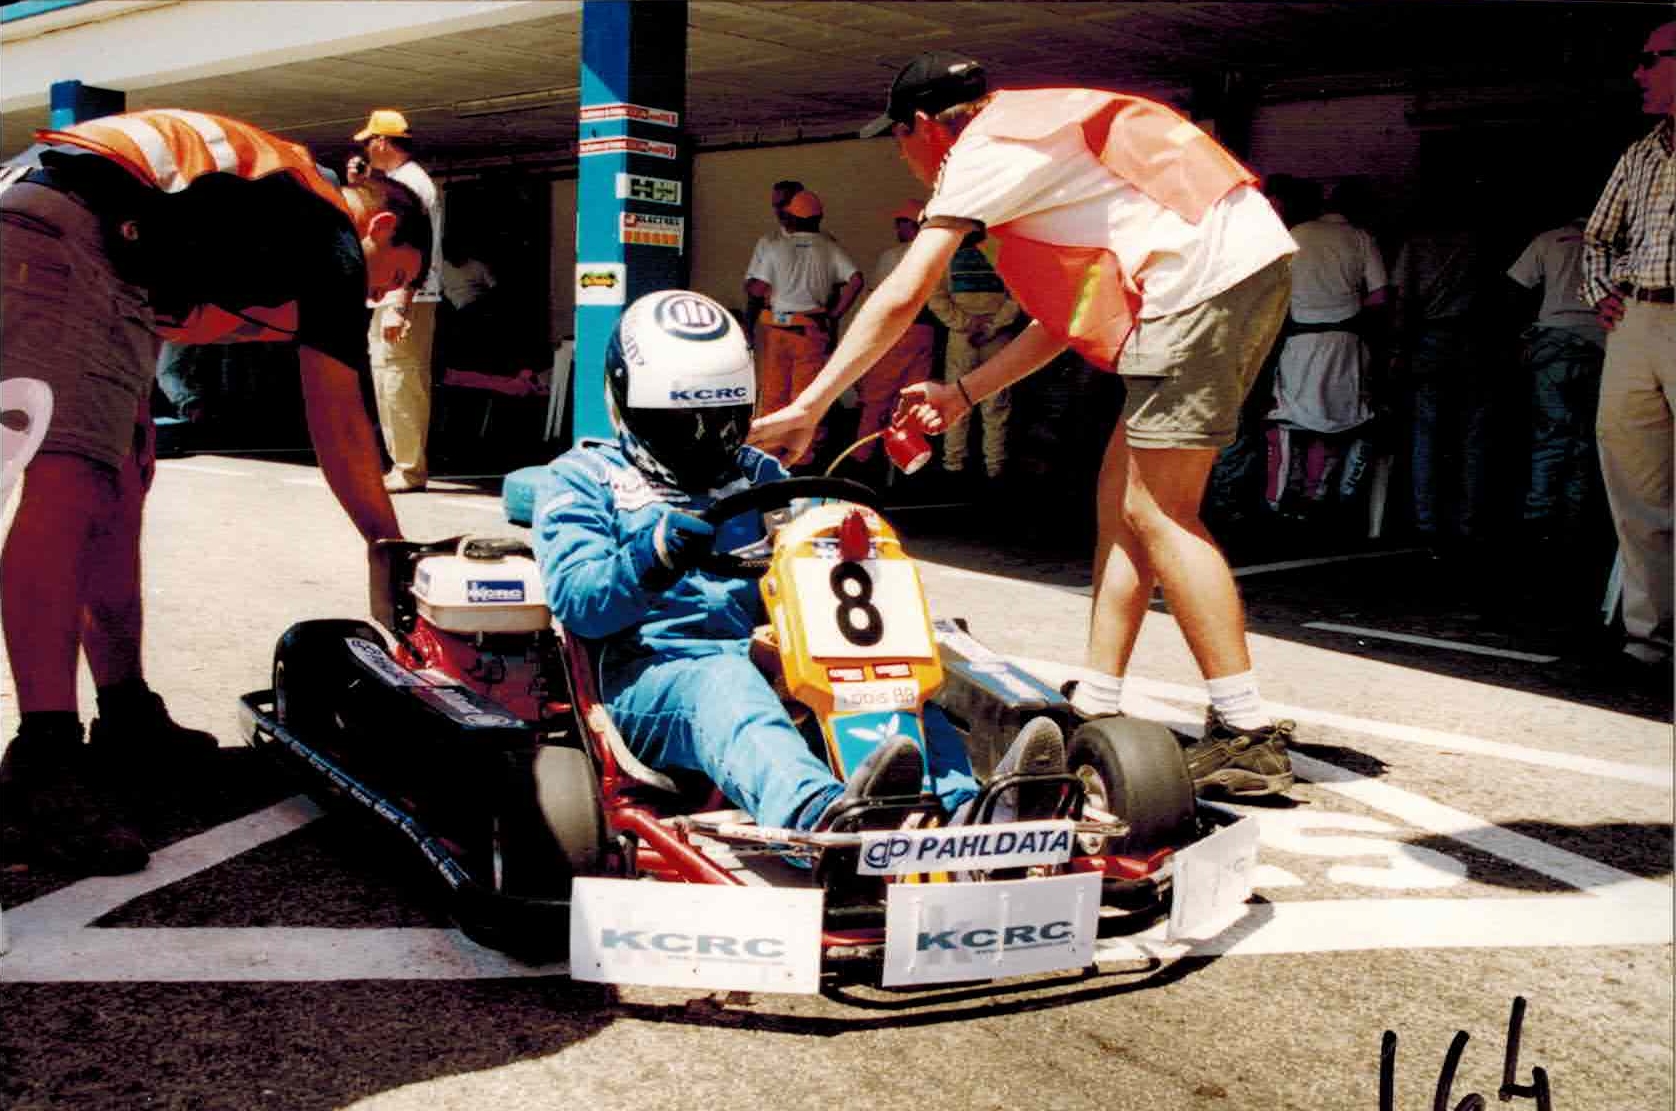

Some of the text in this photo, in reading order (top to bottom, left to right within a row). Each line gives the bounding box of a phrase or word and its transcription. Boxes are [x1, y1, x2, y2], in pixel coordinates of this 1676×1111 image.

[669, 387, 747, 401] KCRC
[830, 561, 884, 646] 8
[916, 830, 1069, 860] PAHLDATA
[600, 926, 786, 959] KCRC
[916, 921, 1073, 951] KCRC
